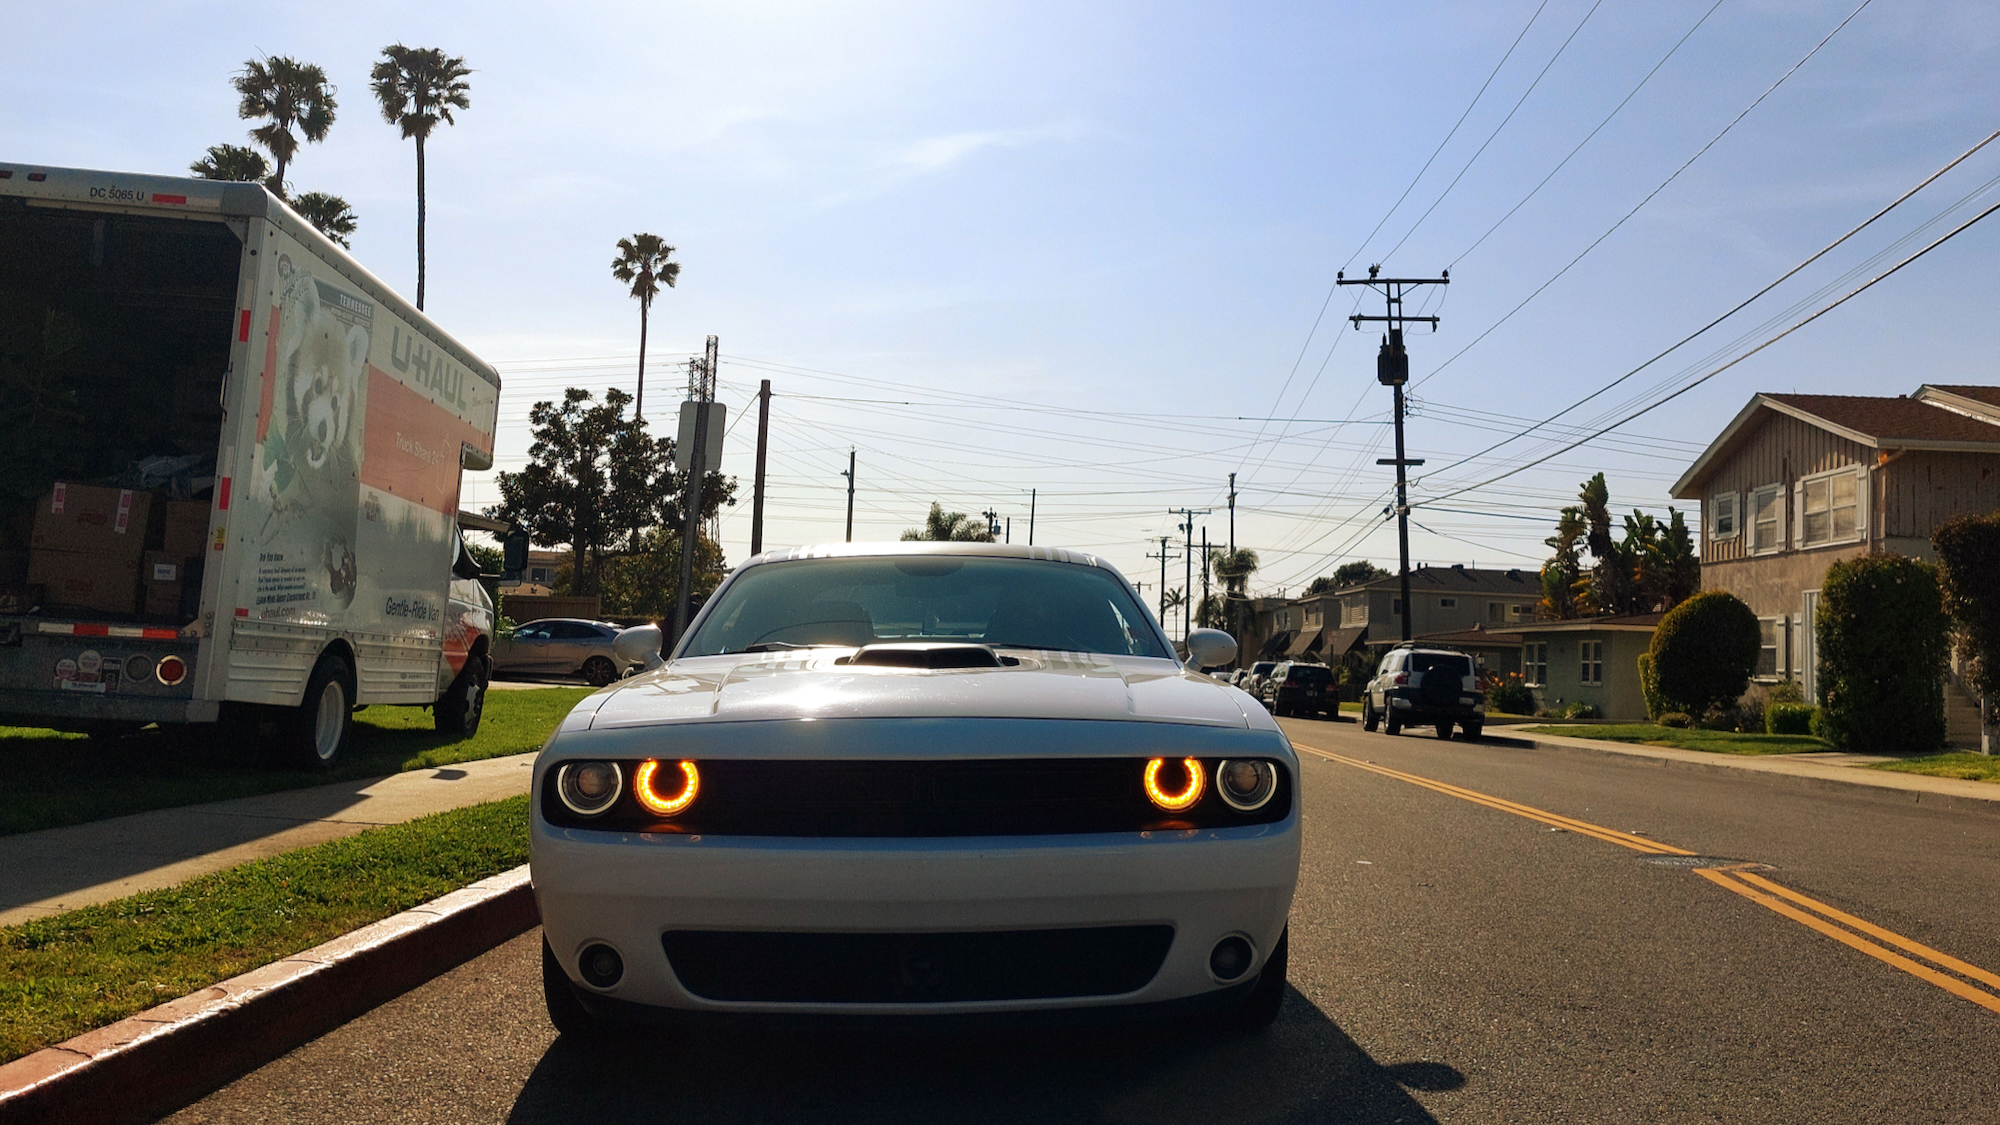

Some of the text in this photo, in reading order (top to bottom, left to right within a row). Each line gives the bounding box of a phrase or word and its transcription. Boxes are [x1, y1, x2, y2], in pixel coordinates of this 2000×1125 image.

[89, 187, 144, 201] DC 5065 U
[340, 293, 372, 318] TENNESSEE
[391, 325, 467, 412] U-HAUL
[396, 431, 414, 453] Truck
[414, 441, 431, 462] Share
[261, 606, 296, 619] uhaul.com
[385, 596, 440, 622] Gentle-Ride Van
